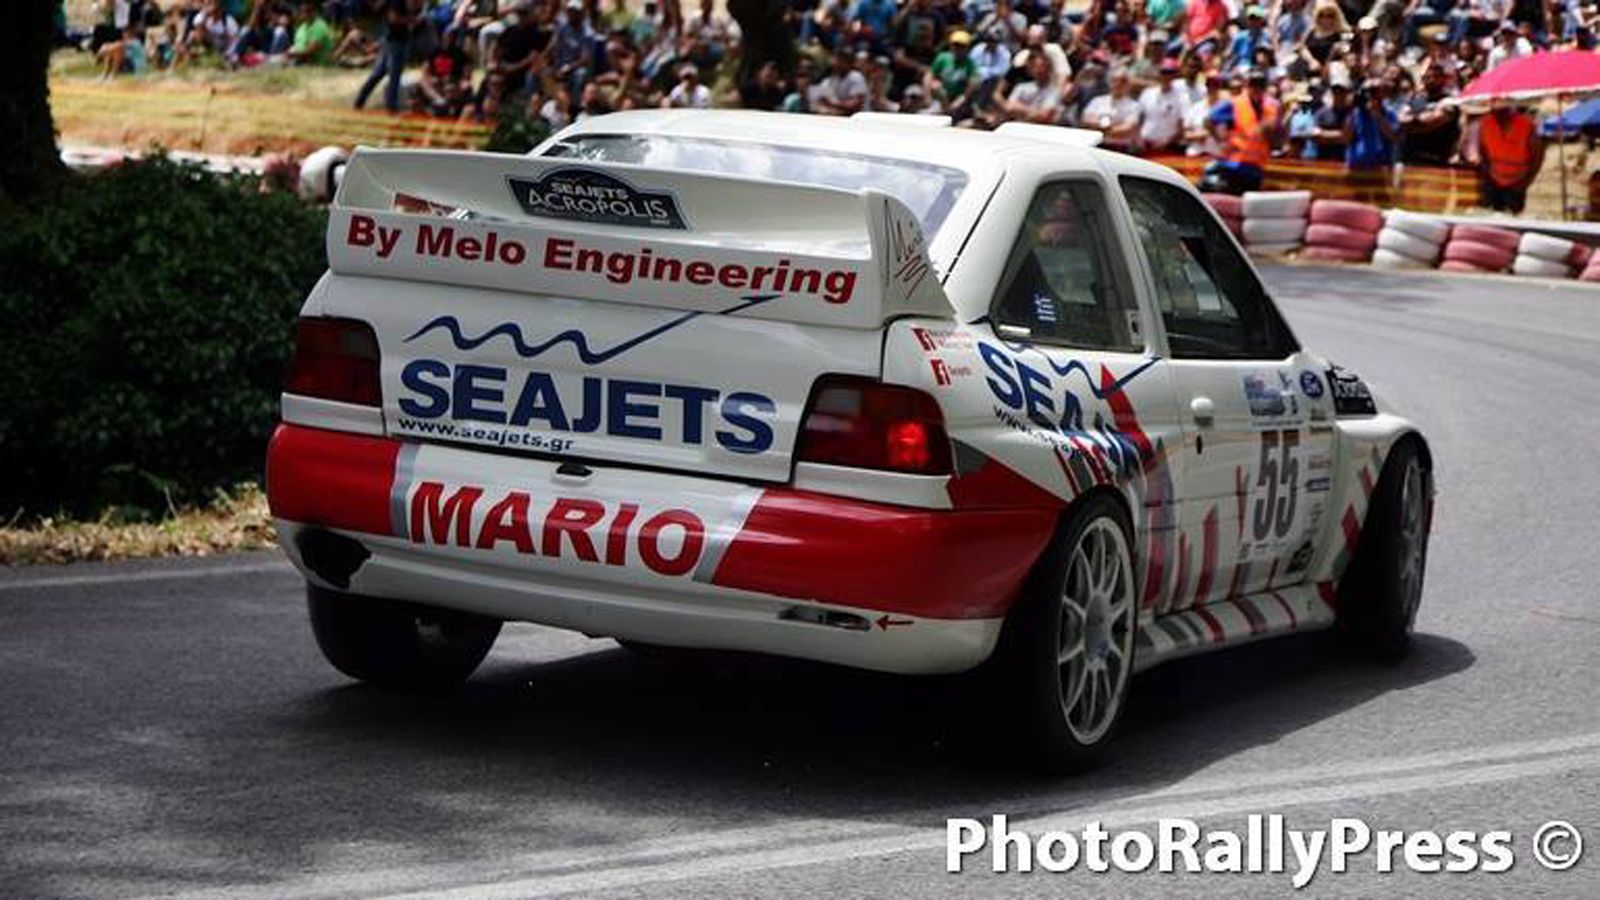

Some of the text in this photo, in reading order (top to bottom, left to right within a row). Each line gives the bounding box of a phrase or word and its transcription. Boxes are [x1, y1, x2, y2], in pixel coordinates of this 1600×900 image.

[528, 189, 669, 220] ACROPOLIS
[550, 181, 629, 200] SEAJETS
[347, 214, 858, 304] By Melo Engineering
[398, 417, 574, 452] www.seajets.gr
[399, 358, 776, 454] SEAJETS
[407, 481, 705, 577] MARIO
[1253, 430, 1300, 541] 55
